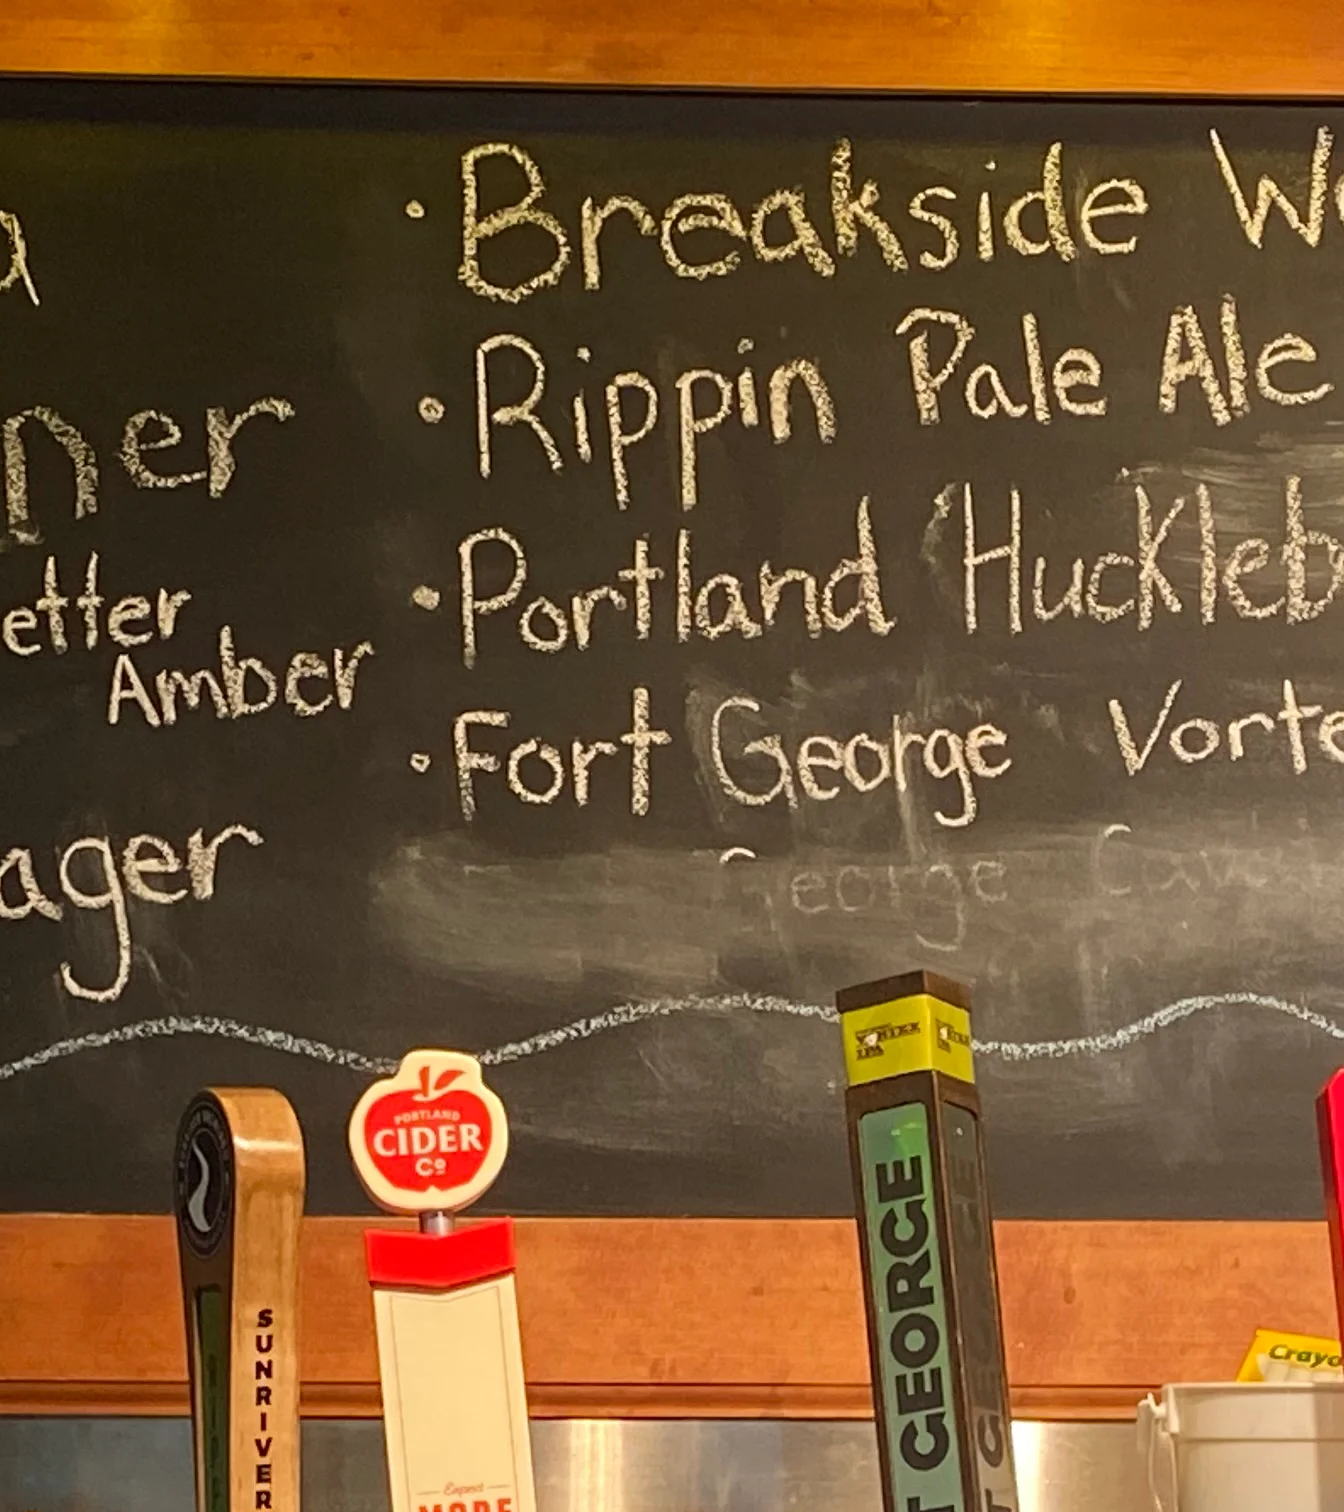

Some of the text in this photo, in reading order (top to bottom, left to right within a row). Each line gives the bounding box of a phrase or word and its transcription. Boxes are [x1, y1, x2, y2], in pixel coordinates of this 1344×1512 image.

[457, 140, 1149, 302] Breakside
[480, 292, 1334, 511] Rippin Pale Ale
[457, 492, 896, 668] Portland
[106, 624, 376, 729] Amber
[451, 686, 669, 824] Fort
[711, 693, 1014, 828] George
[372, 1122, 485, 1157] CIDER
[876, 1154, 951, 1473] GEORGE
[254, 1308, 274, 1512] SUNRIVER
